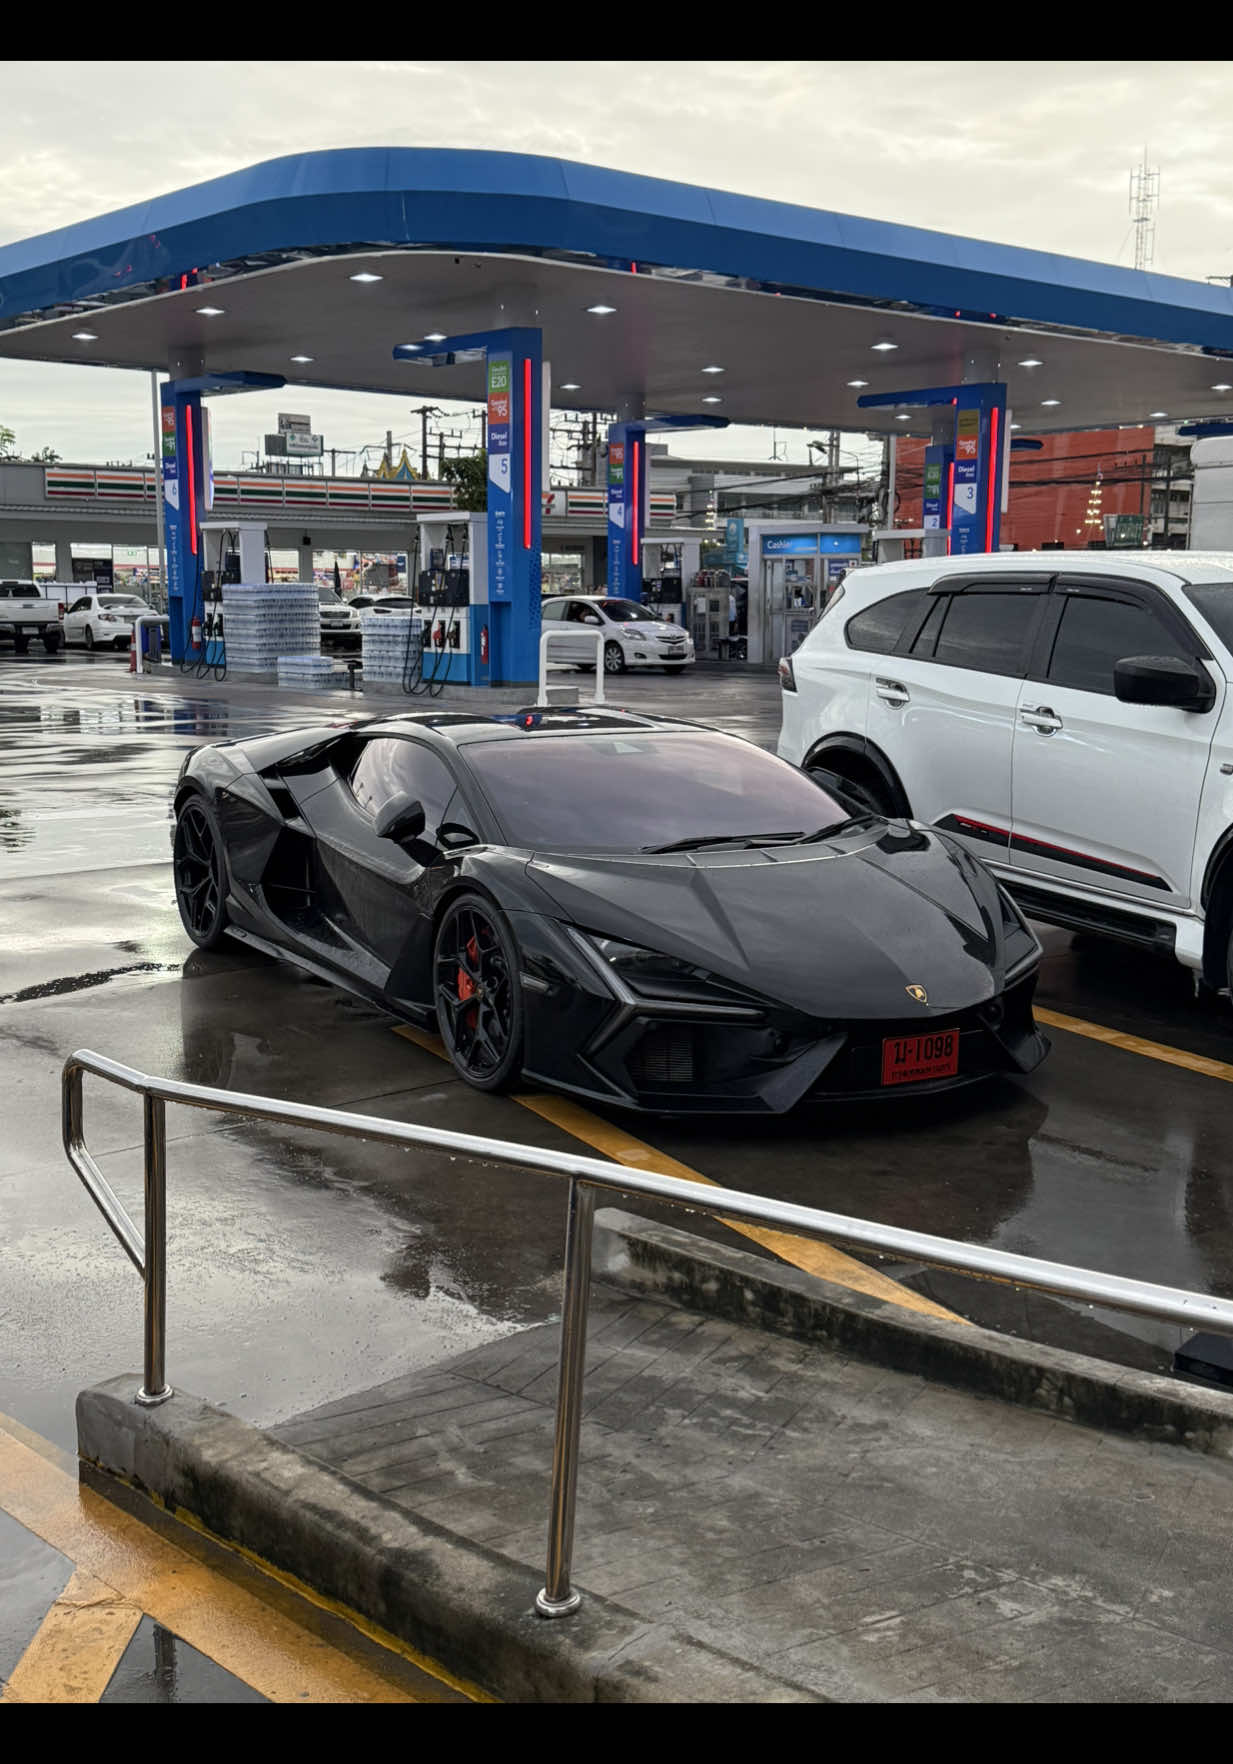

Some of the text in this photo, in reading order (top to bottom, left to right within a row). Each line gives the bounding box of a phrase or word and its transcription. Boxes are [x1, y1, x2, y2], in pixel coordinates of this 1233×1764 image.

[491, 376, 507, 389] E20
[497, 406, 508, 417] 95
[491, 432, 508, 442] Diesel
[500, 457, 508, 474] 5
[966, 486, 974, 500] 3
